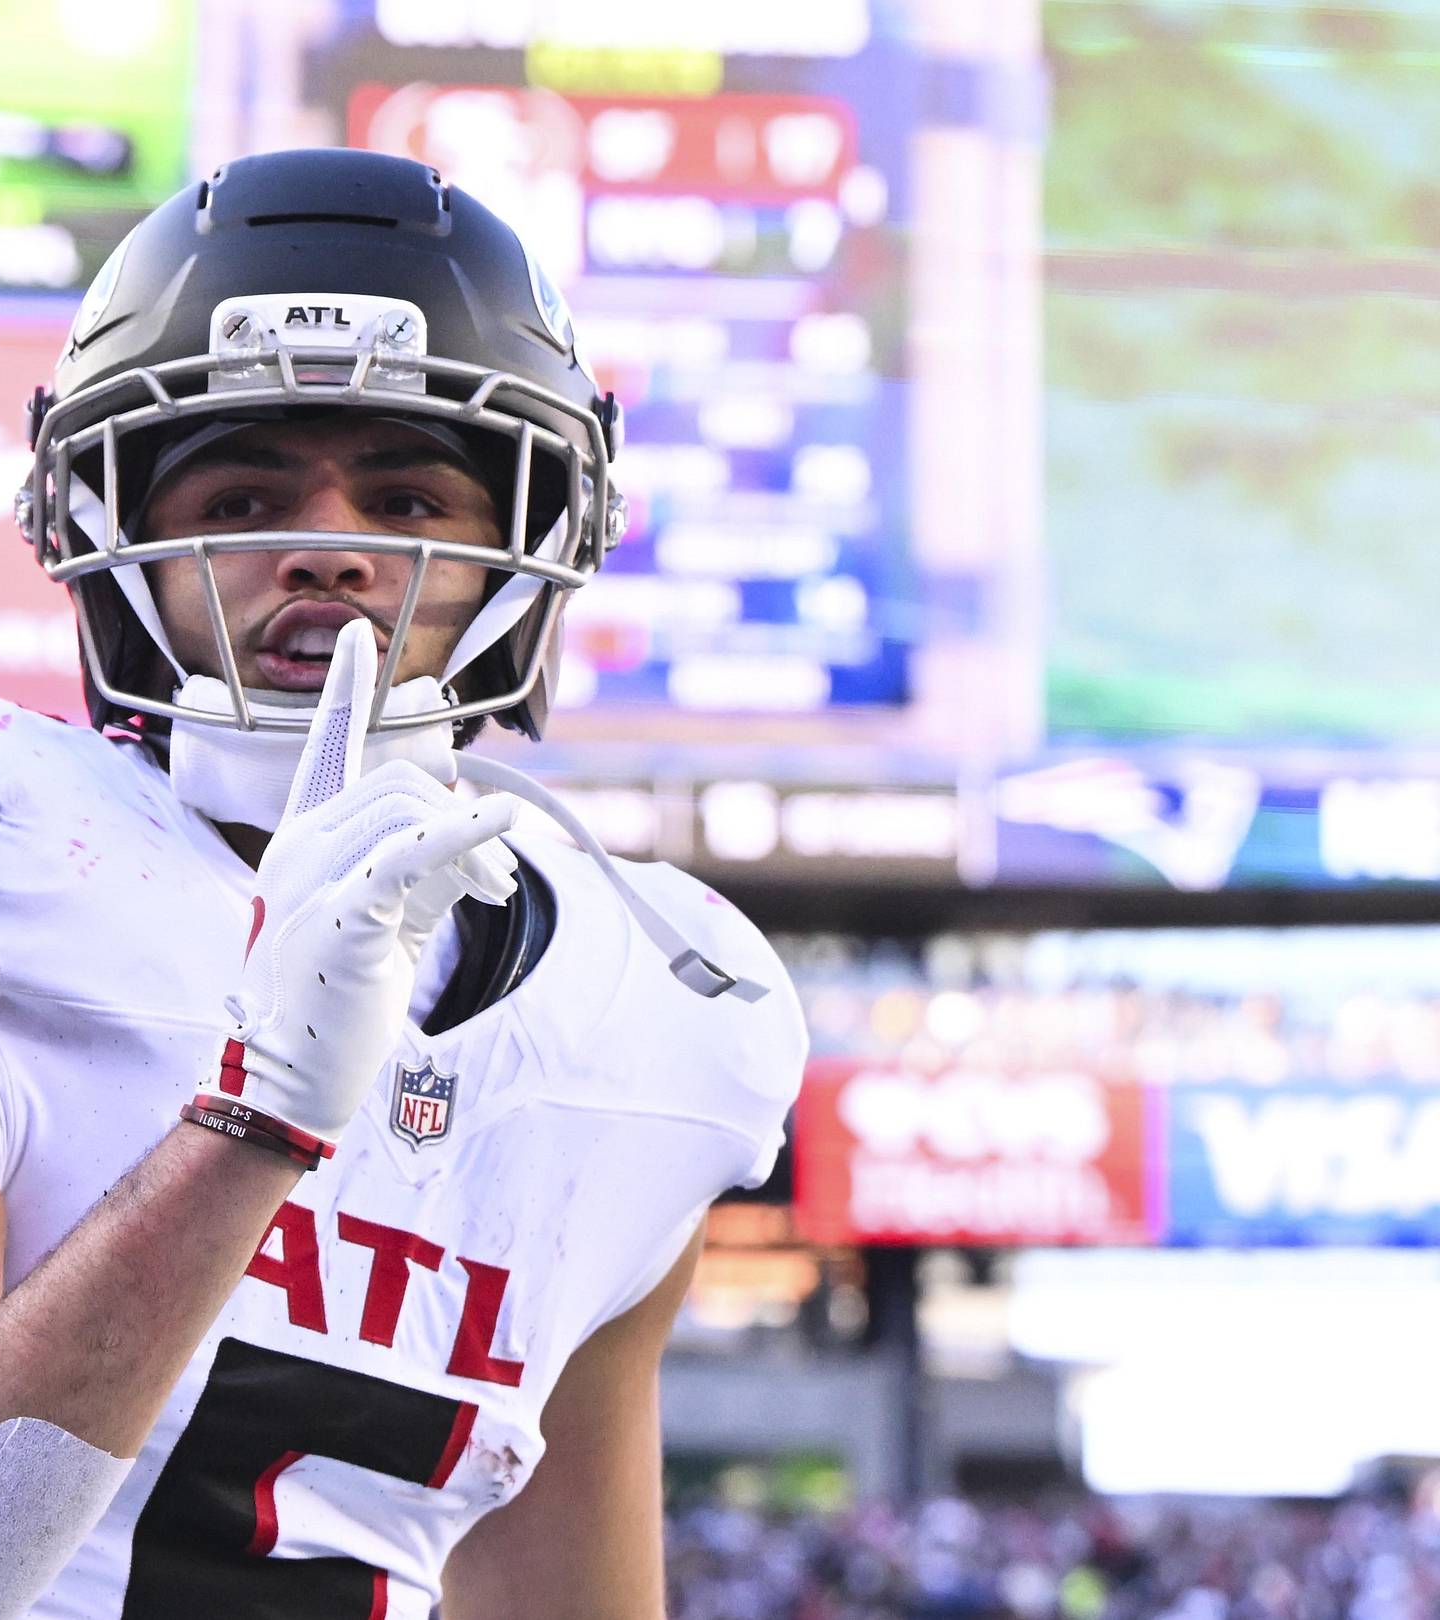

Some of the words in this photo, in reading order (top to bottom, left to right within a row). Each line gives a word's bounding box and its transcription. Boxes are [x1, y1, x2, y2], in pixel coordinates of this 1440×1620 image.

[284, 306, 351, 328] ATL
[230, 1106, 253, 1121] D+S
[400, 1097, 443, 1135] NFL
[202, 1114, 224, 1131] LOVE
[226, 1122, 247, 1138] YOU
[244, 1200, 525, 1388] ATL
